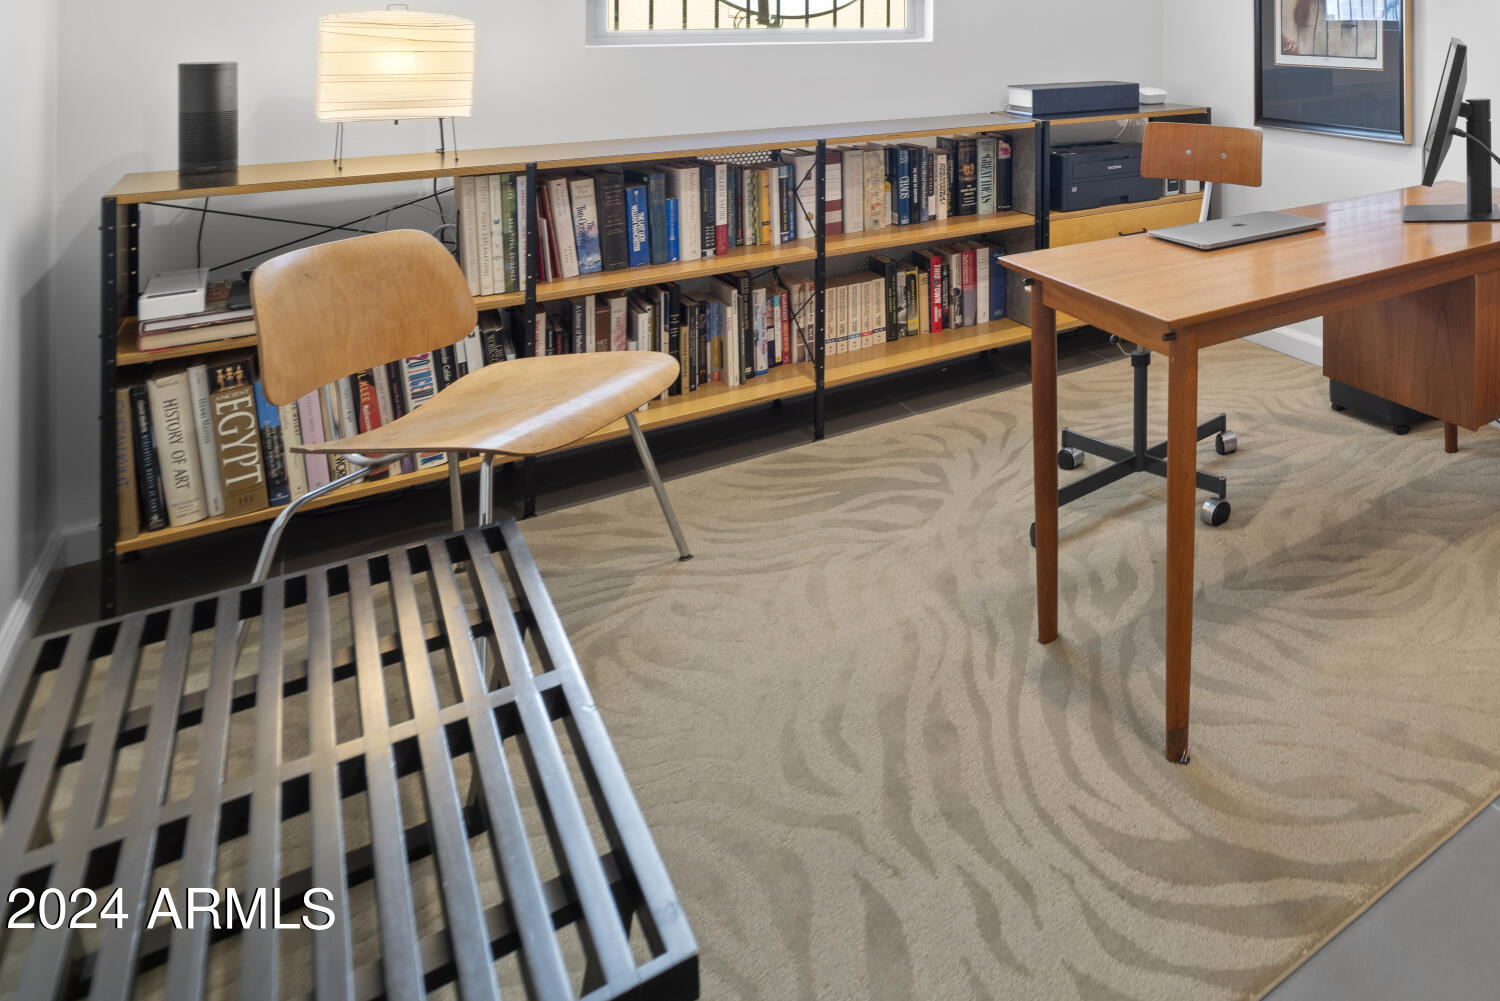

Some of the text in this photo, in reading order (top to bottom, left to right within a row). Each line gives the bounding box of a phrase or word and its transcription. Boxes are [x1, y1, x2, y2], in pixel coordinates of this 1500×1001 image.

[899, 176, 909, 199] CHAOS
[933, 264, 941, 279] THIS
[162, 398, 191, 491] HISTORY OF ART
[215, 394, 263, 488] EGYPT
